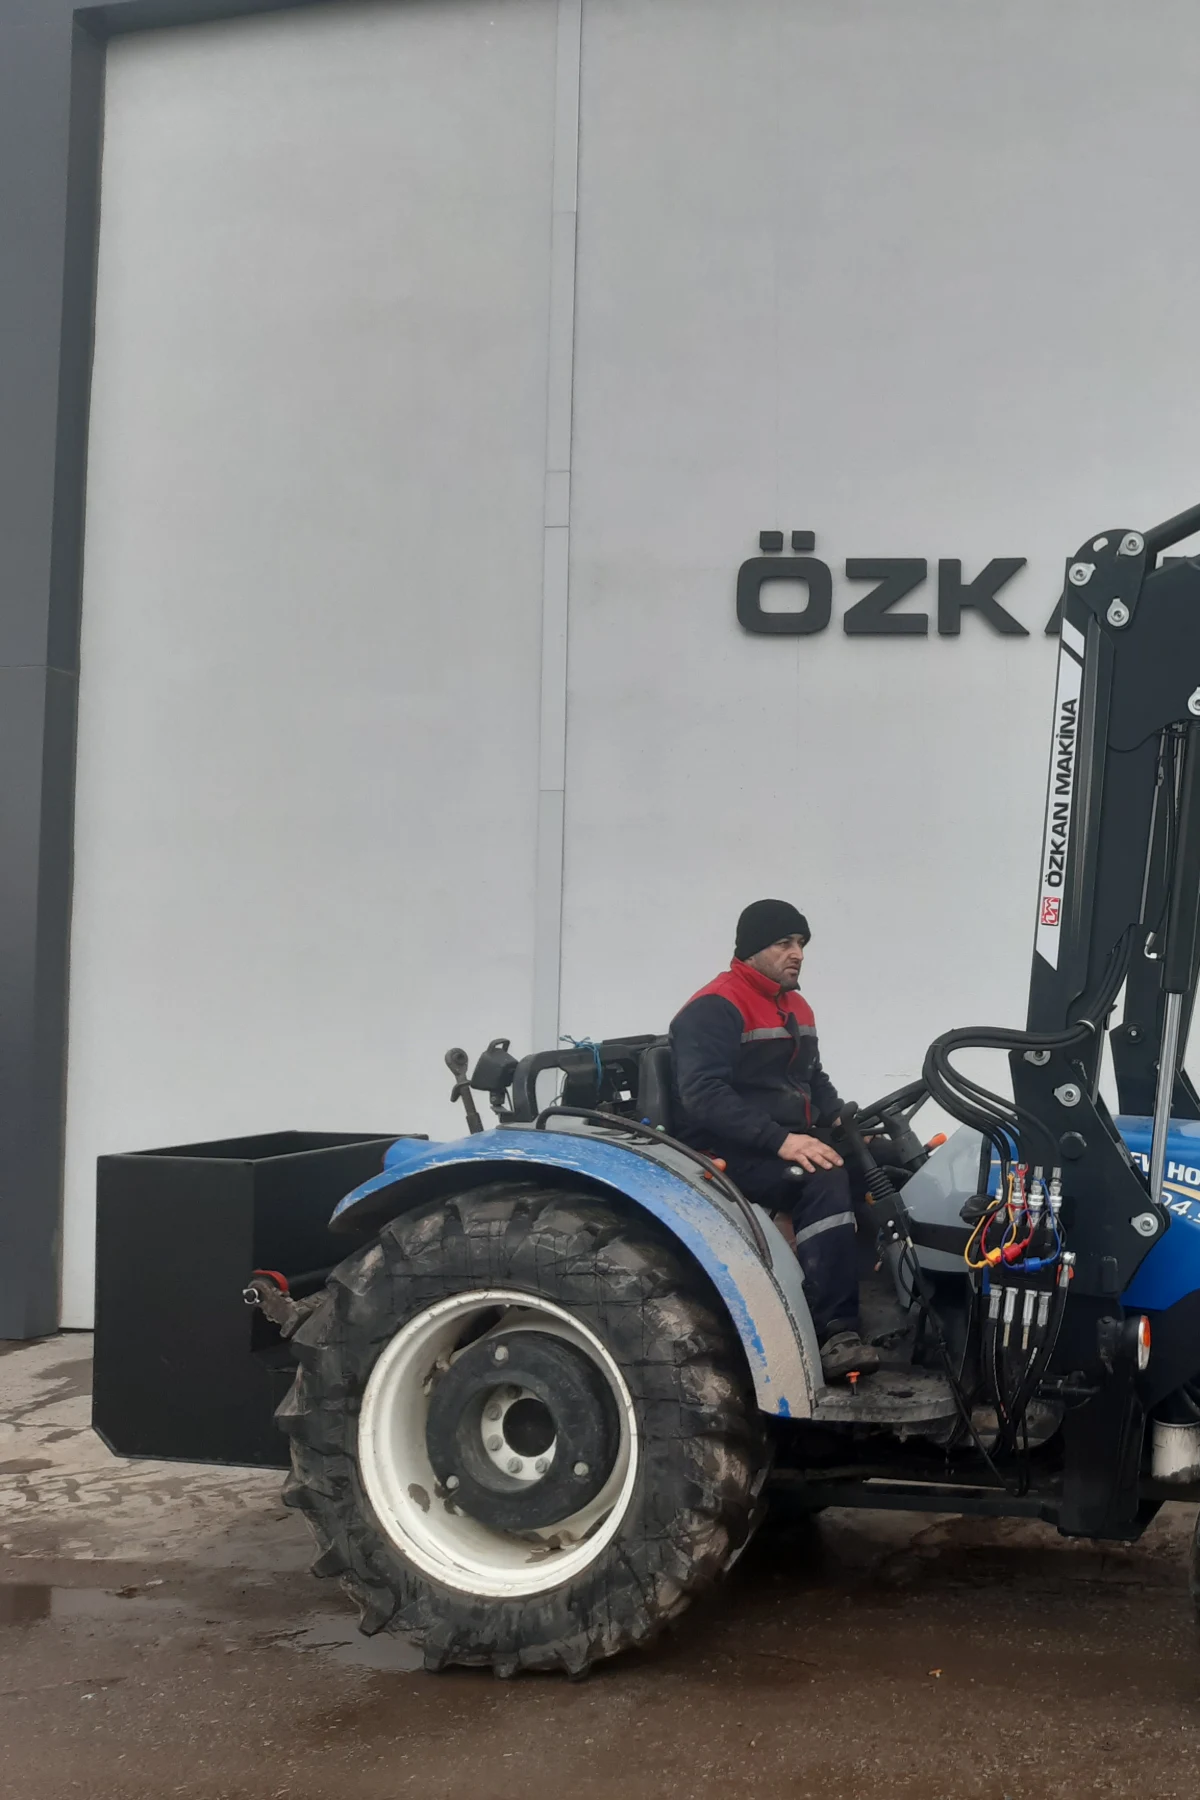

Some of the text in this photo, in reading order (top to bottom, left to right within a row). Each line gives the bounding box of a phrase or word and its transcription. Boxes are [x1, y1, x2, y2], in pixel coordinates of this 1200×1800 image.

[736, 530, 1188, 635] ÖZK
[1054, 698, 1078, 796] MAKİNA
[1044, 802, 1070, 888] ÖZKAN
